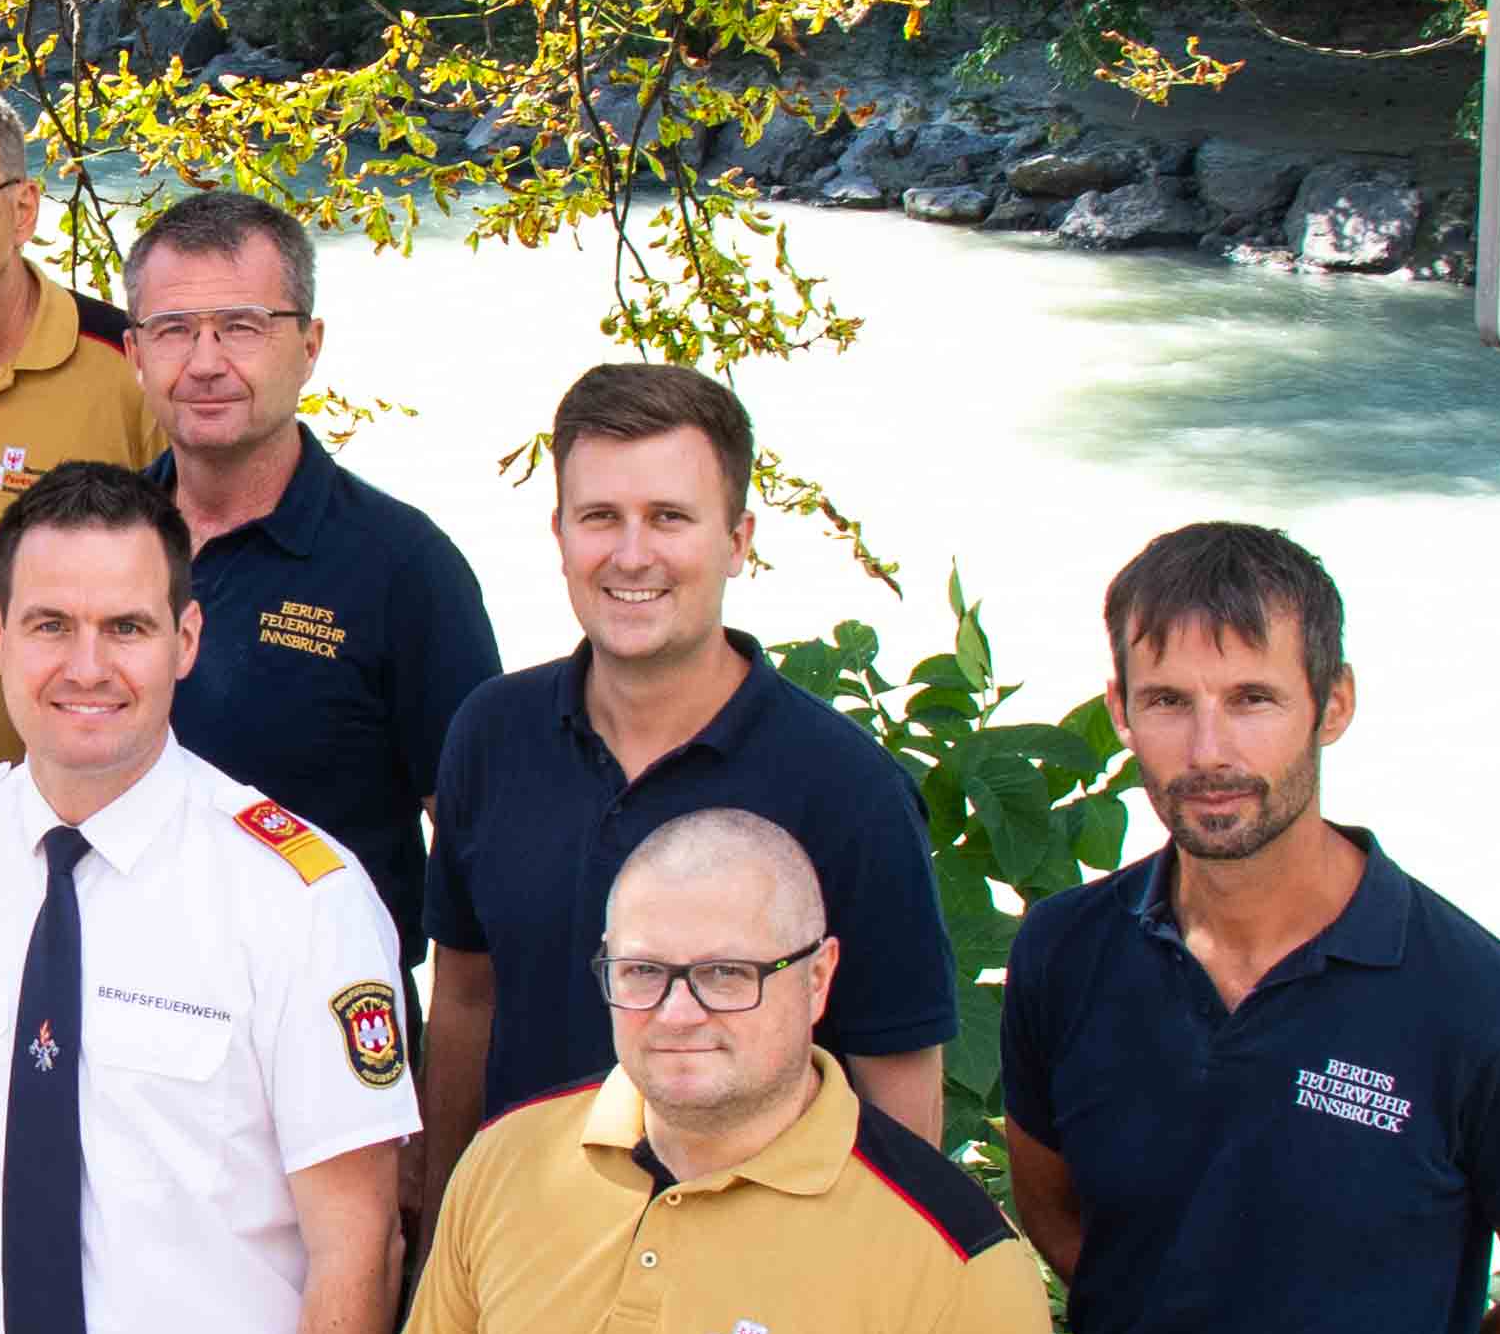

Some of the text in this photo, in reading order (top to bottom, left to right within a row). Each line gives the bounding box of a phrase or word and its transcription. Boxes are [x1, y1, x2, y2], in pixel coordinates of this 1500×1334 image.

[260, 612, 346, 643] FEUERWEHR
[281, 602, 335, 624] BERUFS
[260, 628, 337, 658] INNSBRUCK
[98, 985, 232, 1023] BERUFSFEUERWEHR
[1326, 1058, 1395, 1093] BERUFS
[1296, 1069, 1412, 1118] FEUERWEHR
[1296, 1088, 1403, 1134] INNSBRUCK
